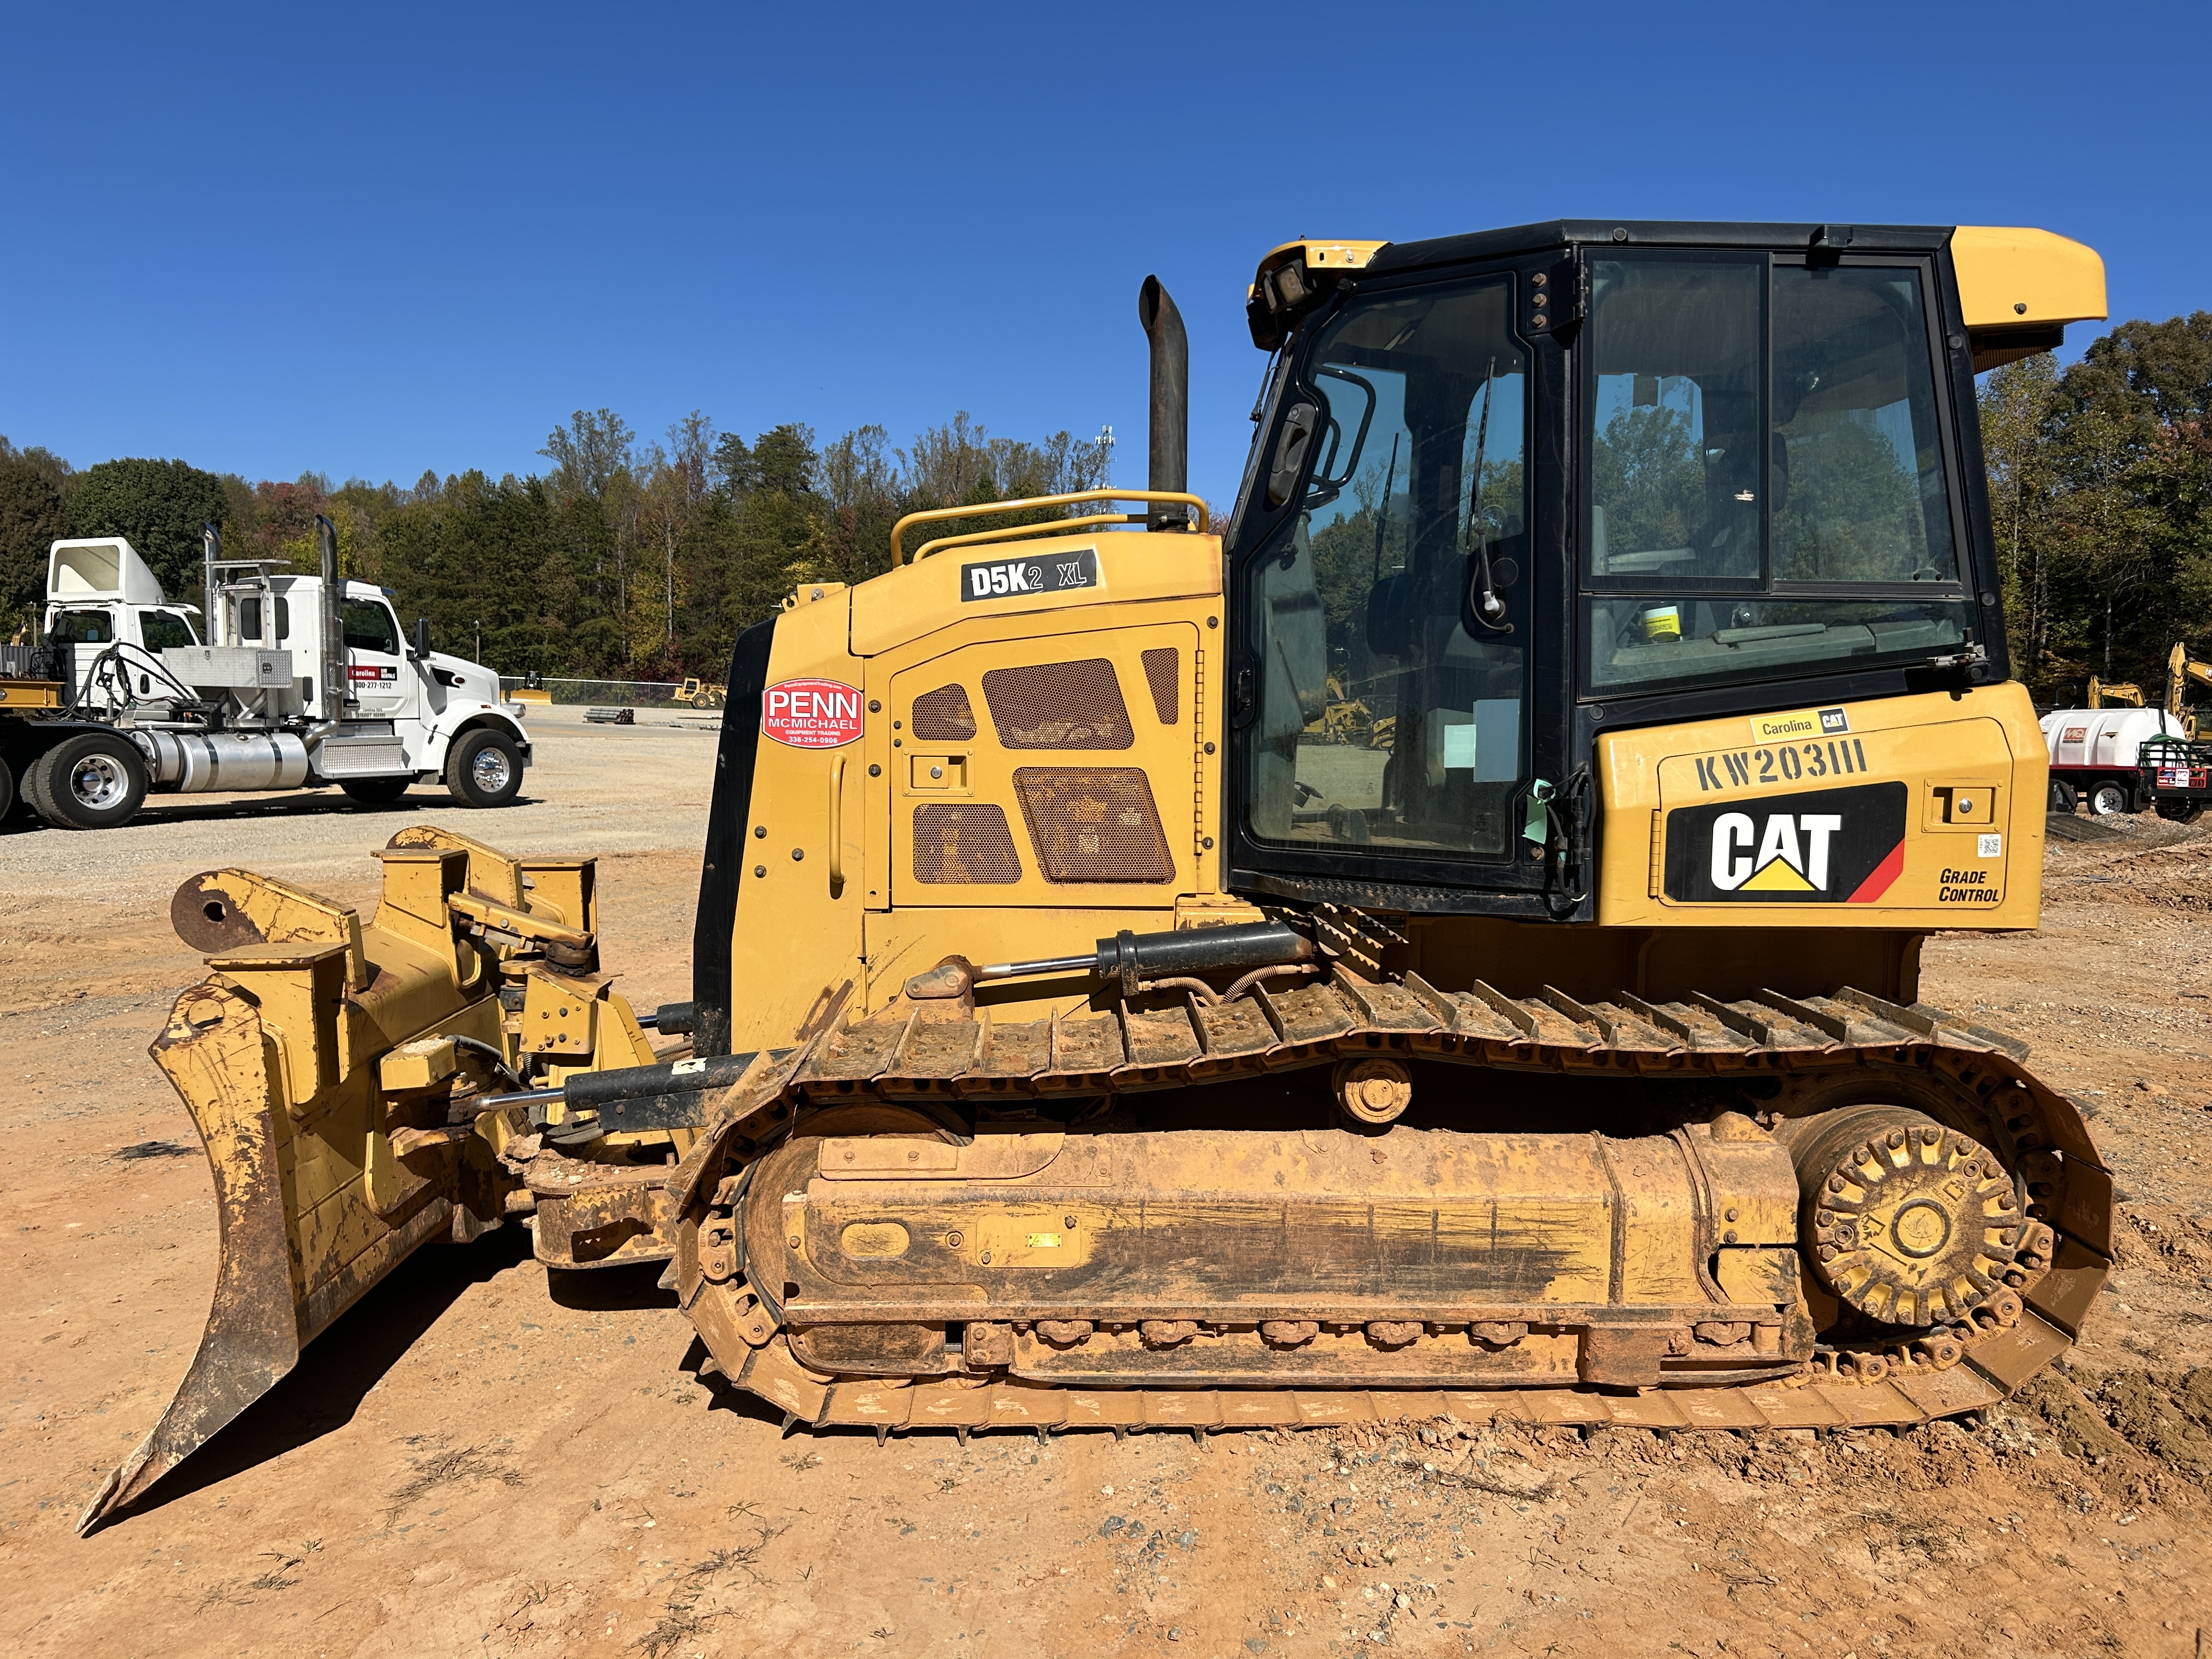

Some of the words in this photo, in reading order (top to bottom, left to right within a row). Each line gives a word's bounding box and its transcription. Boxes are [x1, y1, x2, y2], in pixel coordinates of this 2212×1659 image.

[1056, 562, 1087, 586] XL
[769, 691, 857, 719] PENN
[769, 718, 857, 730] MCMICHAEL
[1762, 720, 1812, 736] Carolina
[1822, 713, 1843, 729] CAT
[1711, 812, 1842, 891] CAT
[1940, 868, 1987, 884] GRADE
[1938, 886, 1999, 901] CONTROL
